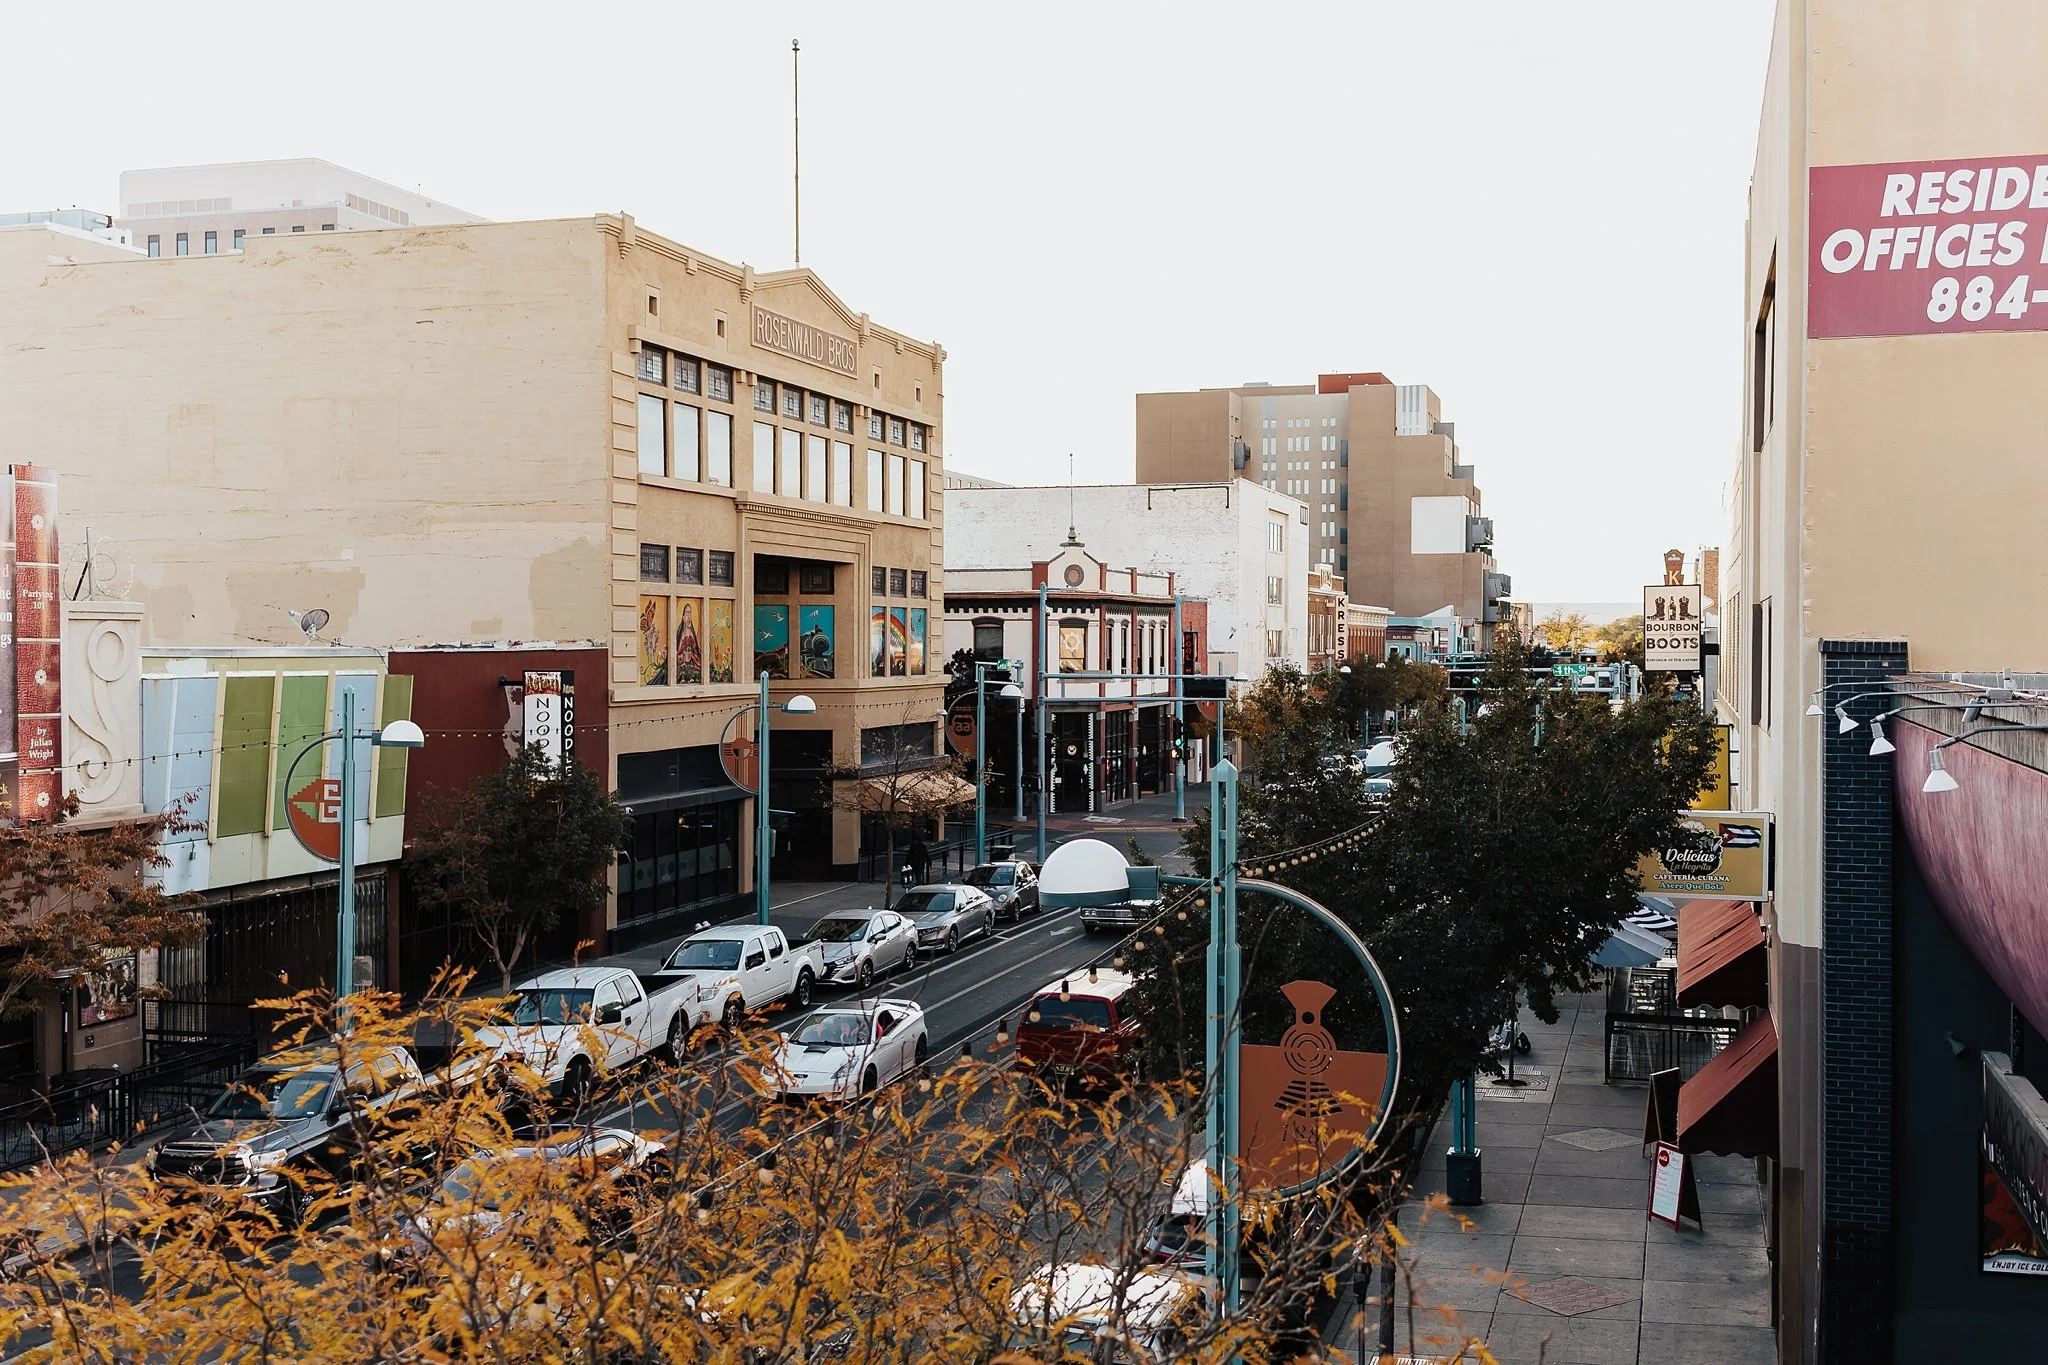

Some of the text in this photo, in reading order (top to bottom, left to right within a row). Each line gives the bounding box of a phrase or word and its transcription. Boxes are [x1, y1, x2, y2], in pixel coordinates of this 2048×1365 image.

[1820, 220, 2028, 274] OFFICES
[757, 310, 823, 361] ROSENWALD
[23, 589, 54, 600] Partying
[33, 602, 45, 610] 101
[1647, 623, 1698, 632] BOURBON
[1647, 638, 1698, 650] BOOTS
[1555, 666, 1574, 675] 4th
[37, 727, 47, 736] by
[31, 739, 52, 748] Julian
[29, 751, 54, 760] Wright
[1671, 862, 1680, 870] La
[1685, 882, 1702, 890] Que
[1992, 1261, 2016, 1269] ENJOY
